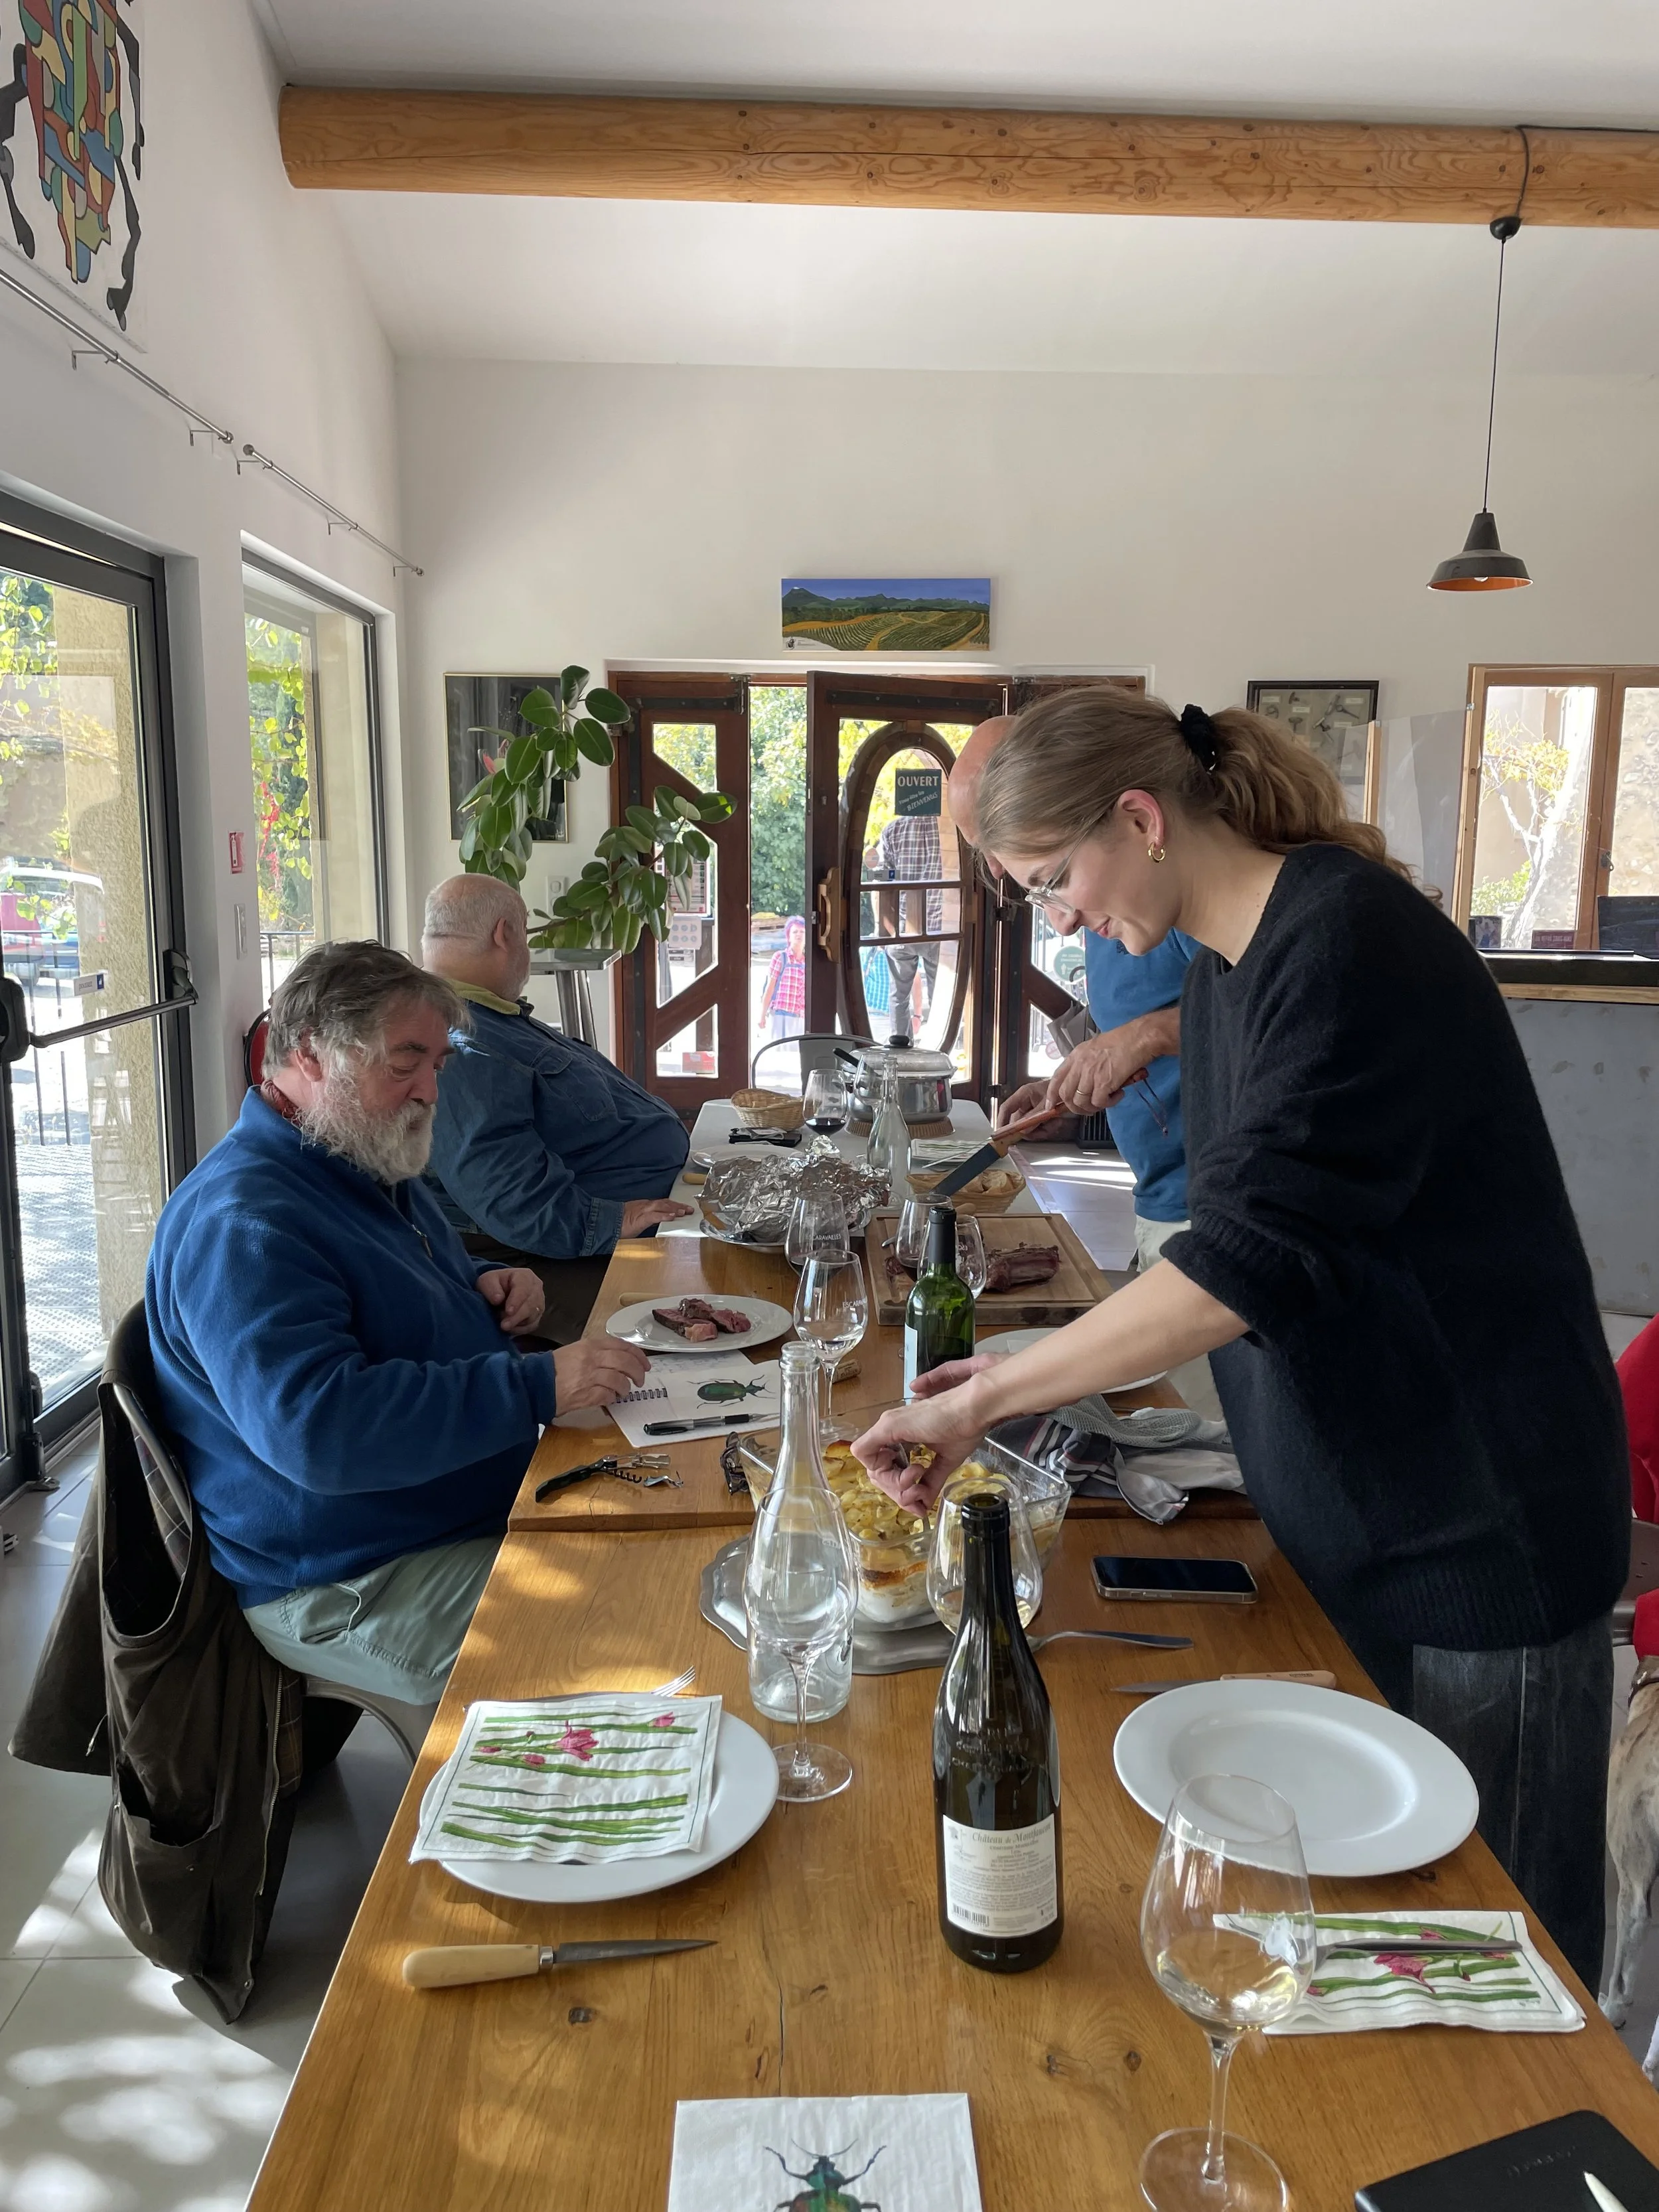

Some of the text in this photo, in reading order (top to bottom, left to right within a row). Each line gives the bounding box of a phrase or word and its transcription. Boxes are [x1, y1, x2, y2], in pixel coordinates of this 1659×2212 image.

[897, 775, 939, 786] OUVERT
[906, 792, 938, 812] BIENVENUS
[972, 1831, 1003, 1844] Château
[1012, 1822, 1051, 1844] Montfaucon
